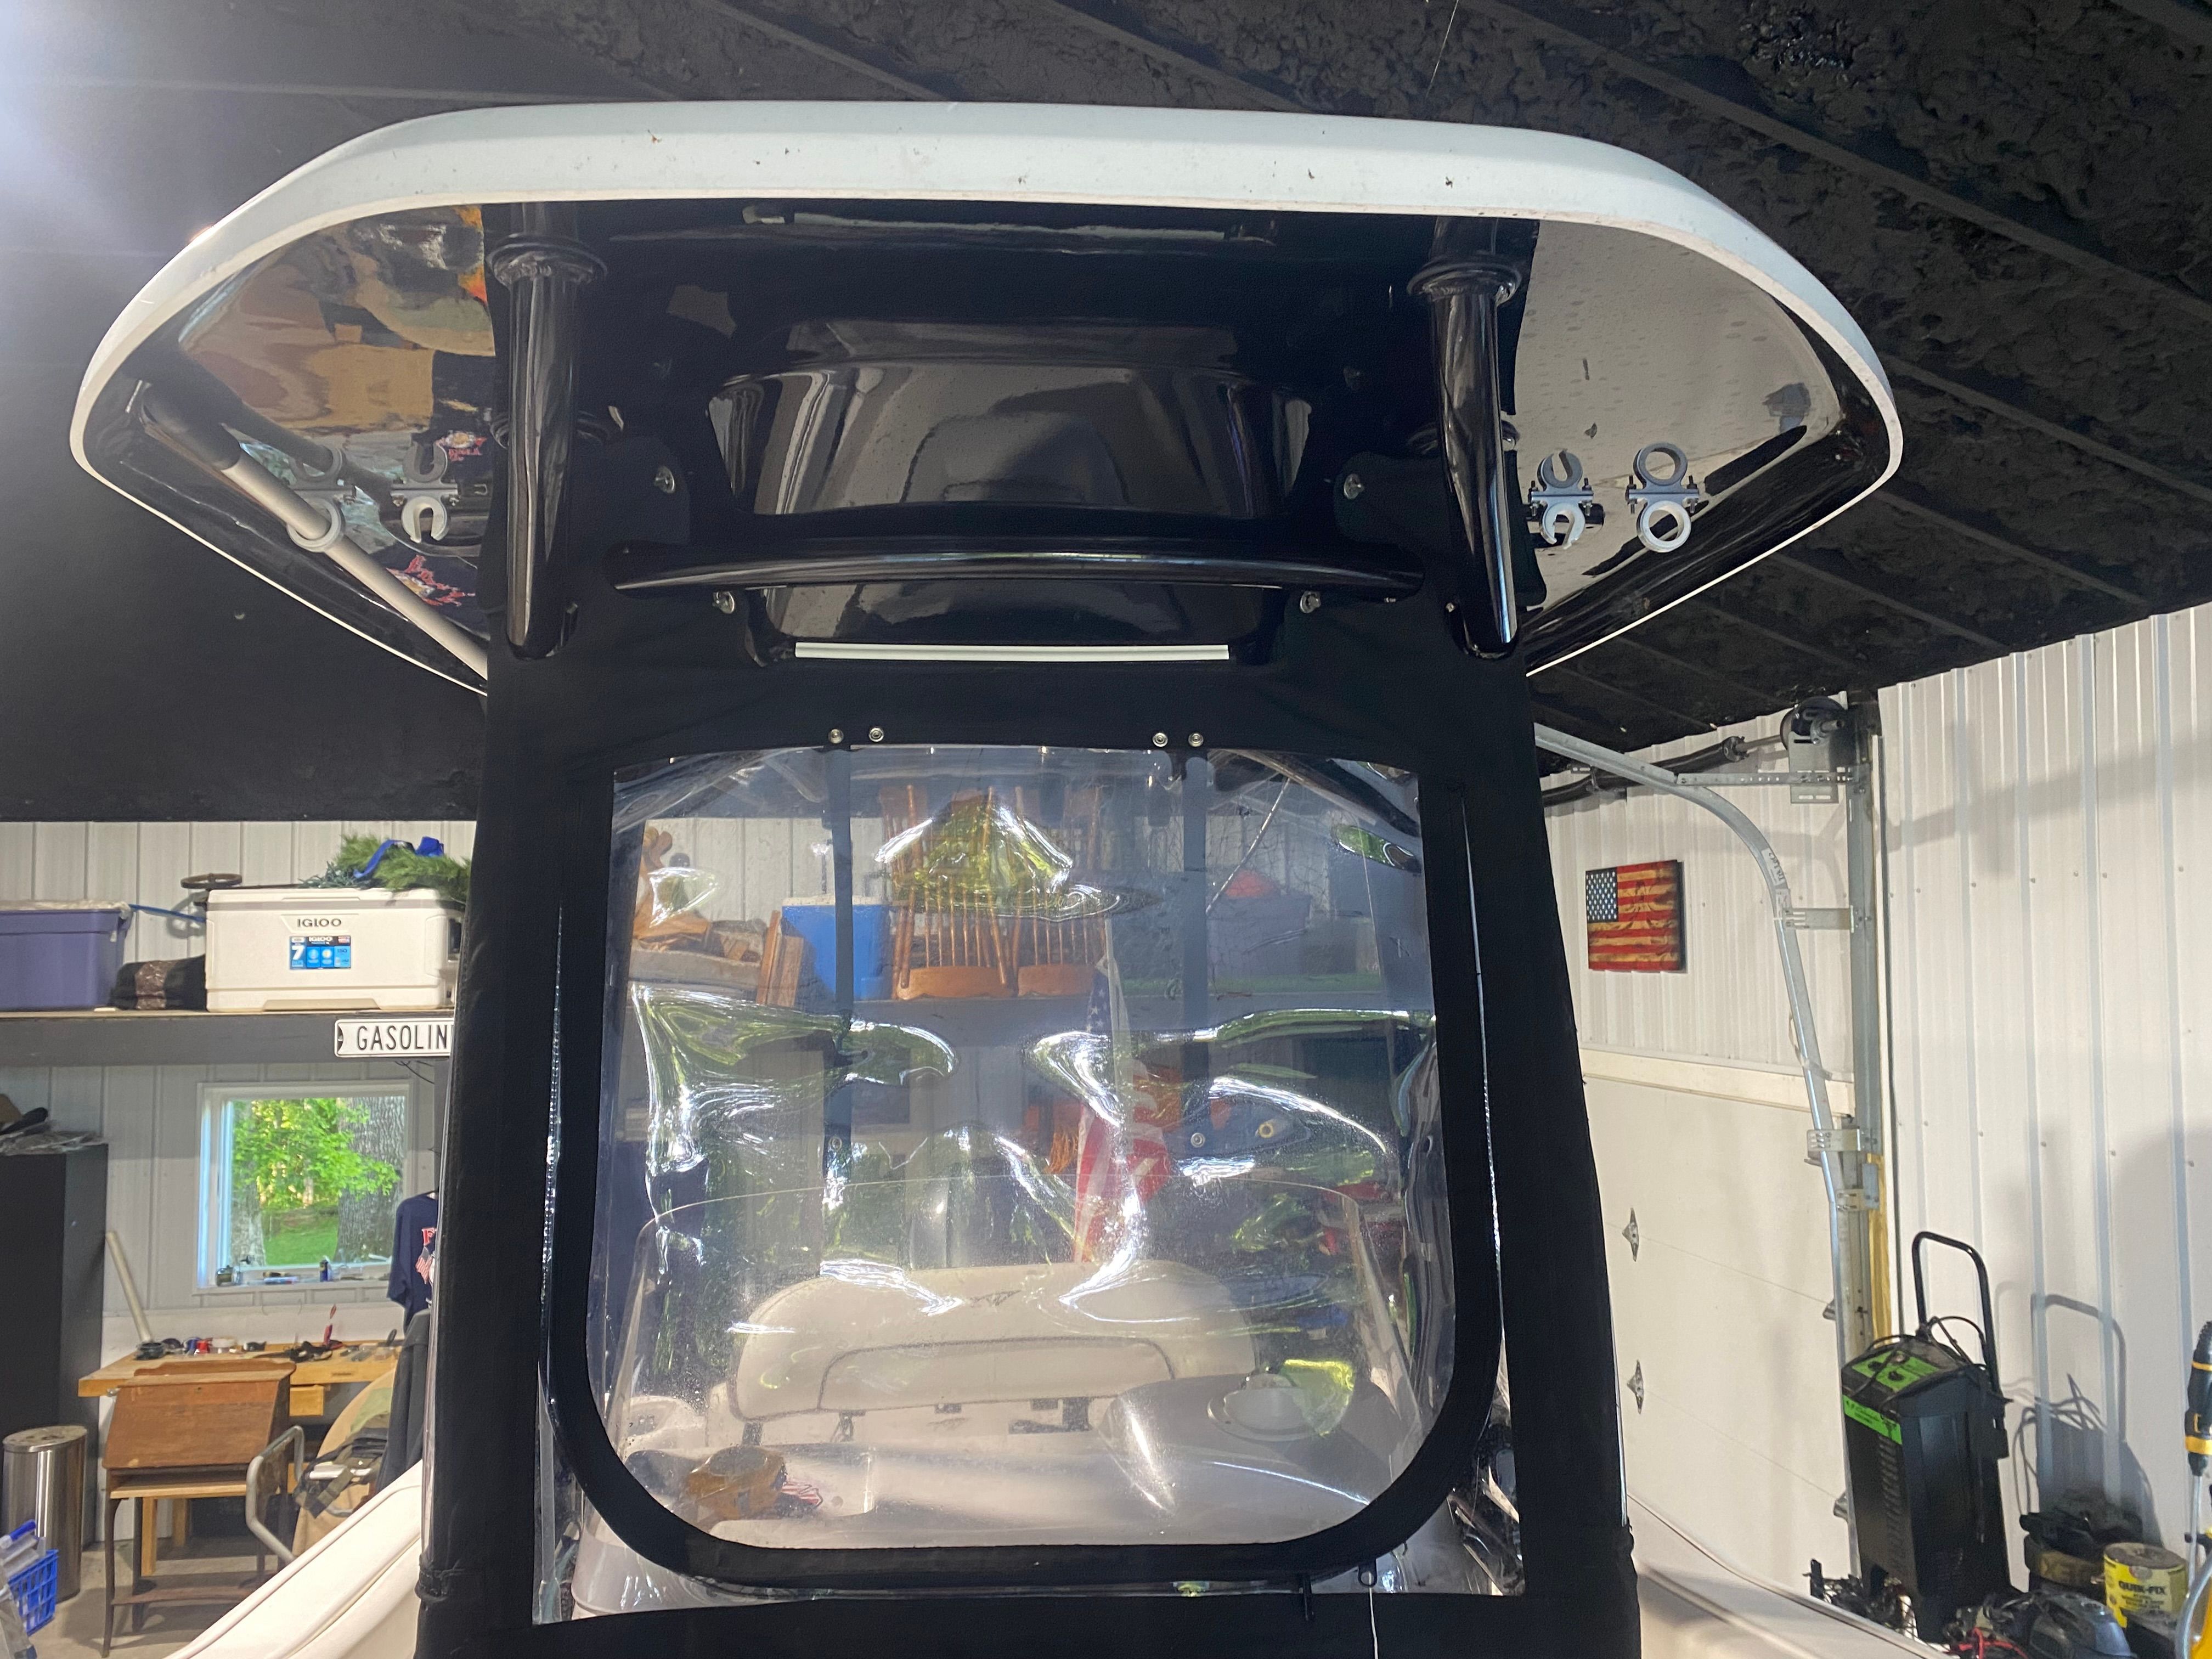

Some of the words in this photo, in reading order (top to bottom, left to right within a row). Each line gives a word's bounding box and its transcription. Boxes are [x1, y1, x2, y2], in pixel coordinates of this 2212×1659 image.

[297, 918, 342, 927] IGLOO
[291, 945, 305, 960] 7
[357, 1024, 454, 1050] GASOLIN
